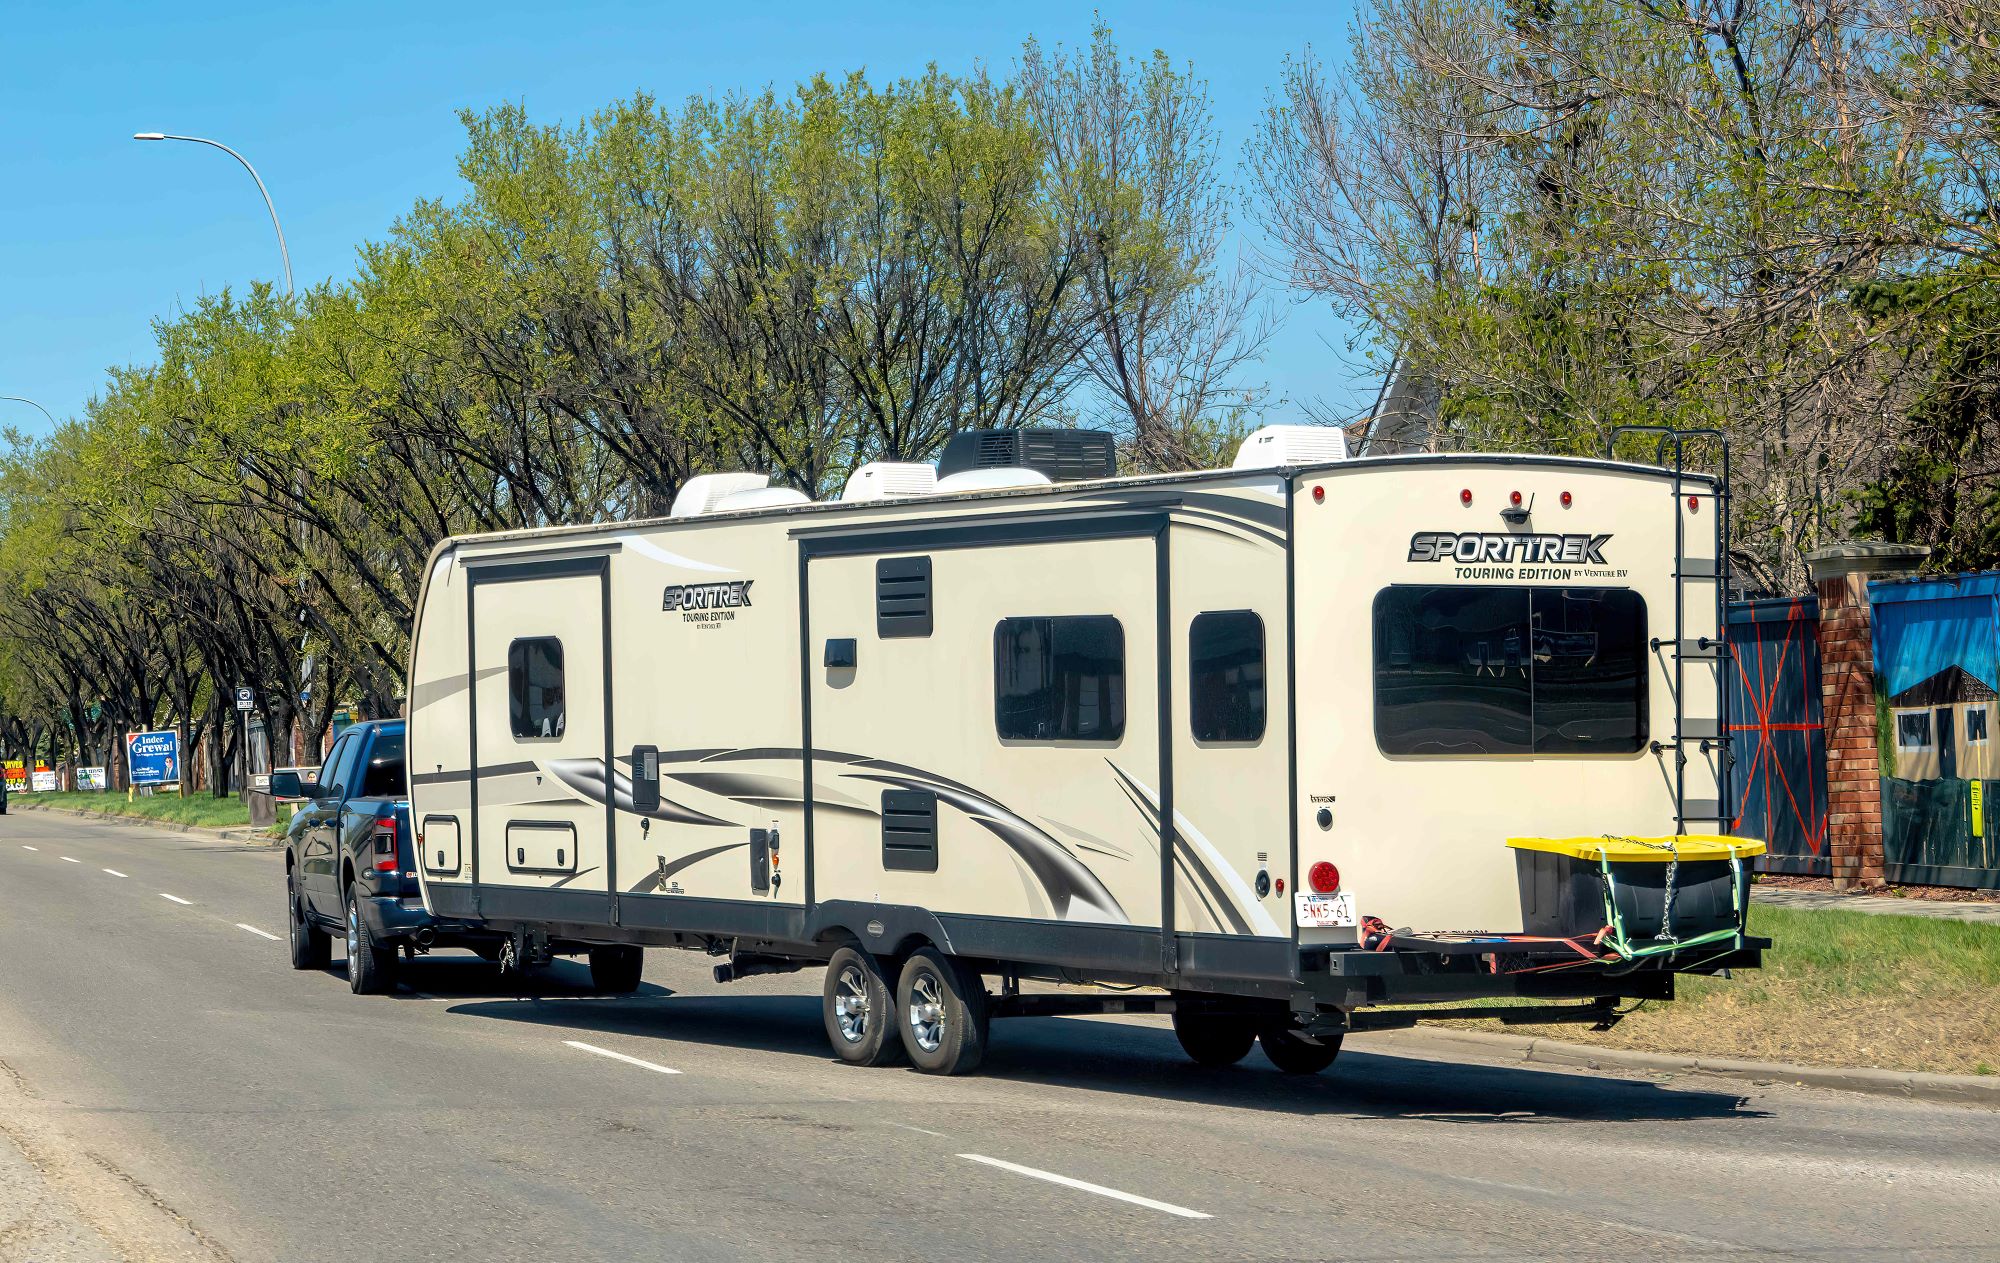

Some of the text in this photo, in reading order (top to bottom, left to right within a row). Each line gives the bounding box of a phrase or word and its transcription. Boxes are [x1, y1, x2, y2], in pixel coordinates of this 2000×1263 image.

[1407, 531, 1614, 565] SPORTTREK
[1455, 567, 1514, 579] TOURING
[1518, 568, 1571, 580] EDITION
[1617, 569, 1628, 578] RV
[662, 580, 754, 611] SPORTTREK
[683, 611, 735, 622] TOURING EDITION
[142, 736, 164, 744] Inder
[132, 741, 173, 753] Grewal
